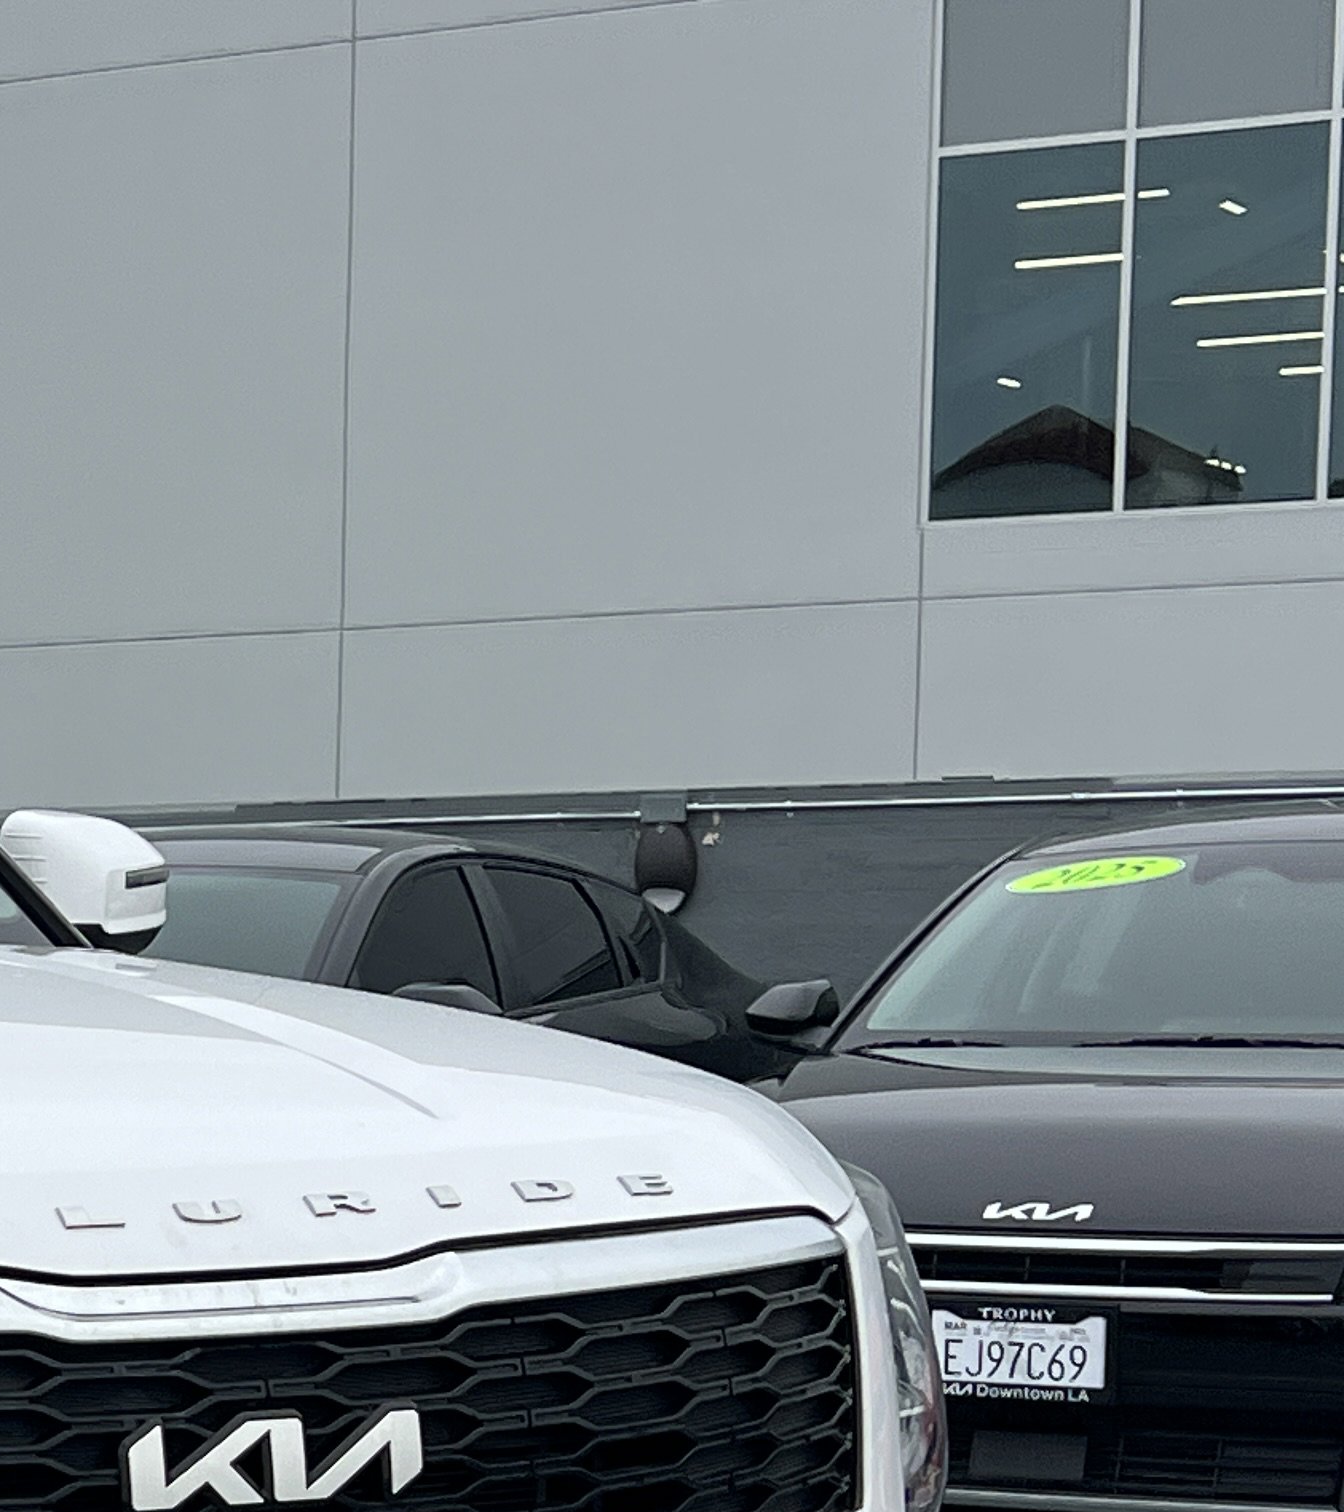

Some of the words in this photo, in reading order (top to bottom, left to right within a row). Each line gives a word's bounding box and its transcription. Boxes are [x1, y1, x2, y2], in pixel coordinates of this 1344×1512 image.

[981, 1201, 1094, 1221] KIA
[977, 1306, 1056, 1322] TROPHY
[944, 1337, 1088, 1383] EJ97C69
[976, 1384, 1064, 1400] Downtown
[1067, 1388, 1090, 1403] LA
[124, 1404, 424, 1512] KIA
